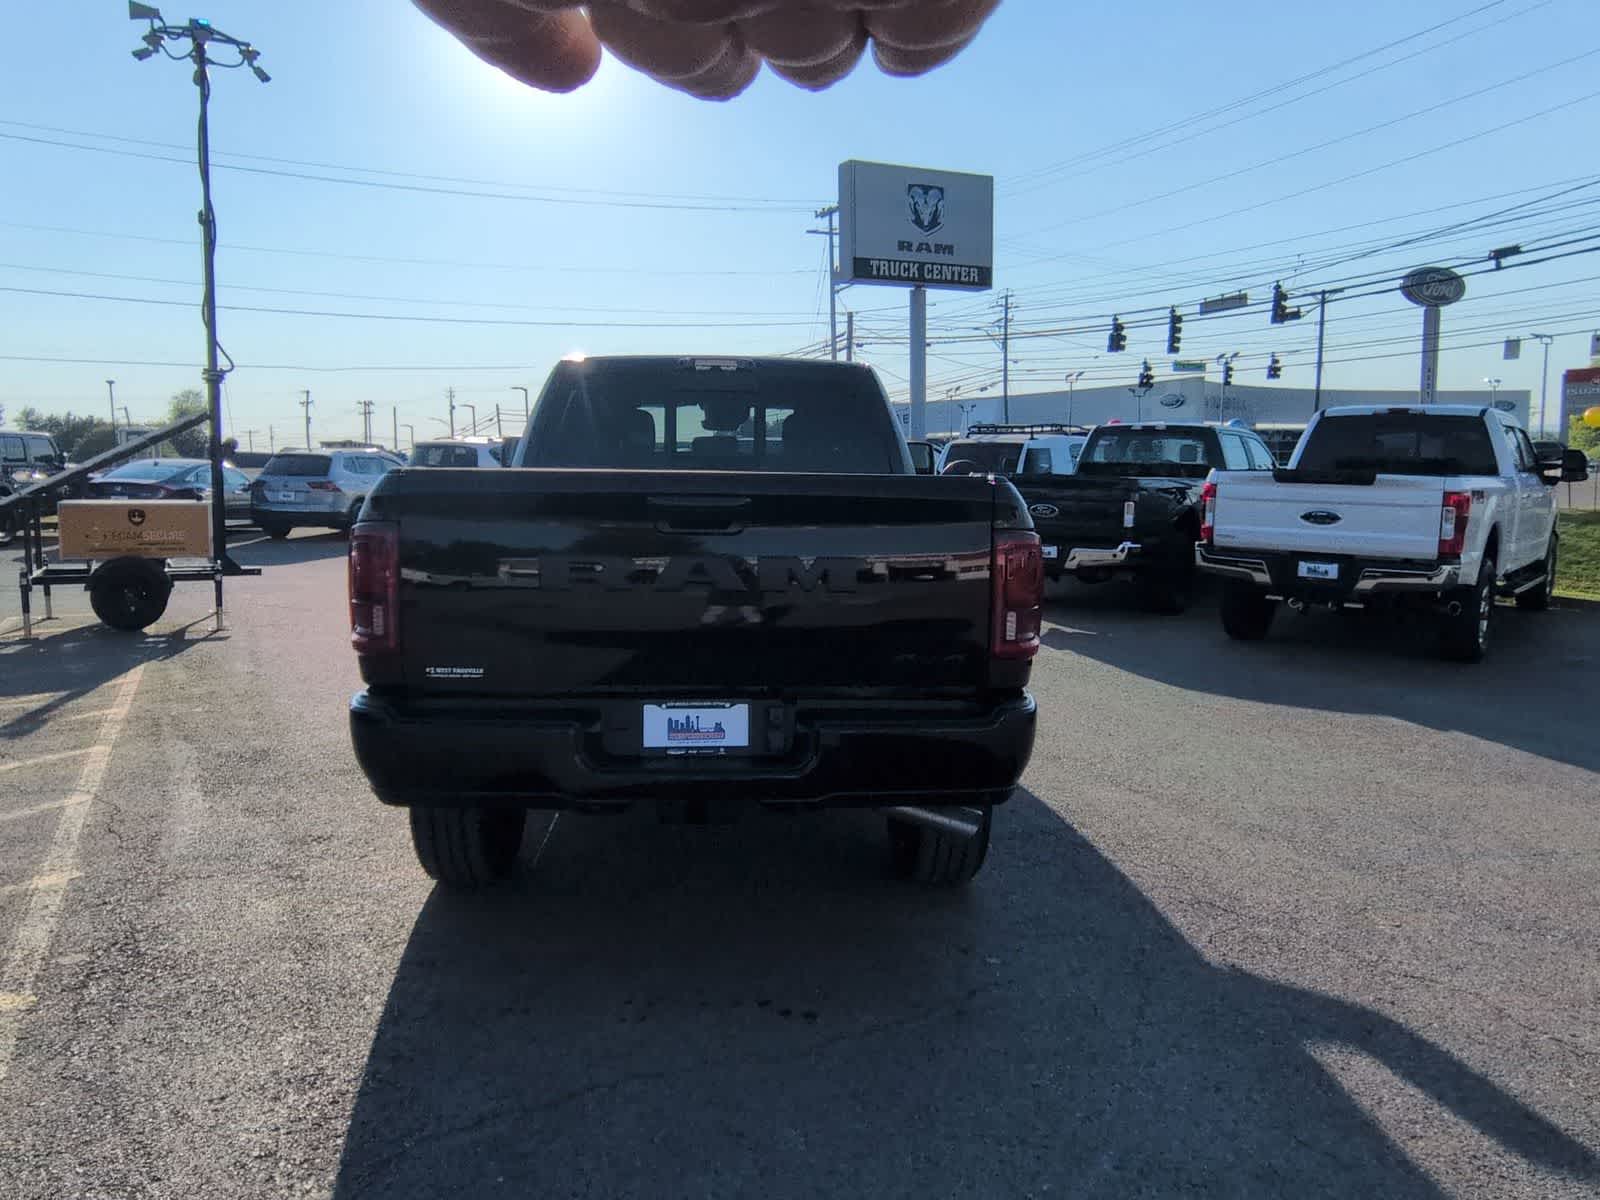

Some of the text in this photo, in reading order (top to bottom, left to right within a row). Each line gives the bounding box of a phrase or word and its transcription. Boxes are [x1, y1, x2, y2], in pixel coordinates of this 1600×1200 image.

[897, 240, 955, 256] RAM
[870, 260, 978, 282] TRUCK CENTER
[1423, 273, 1457, 297] Ford
